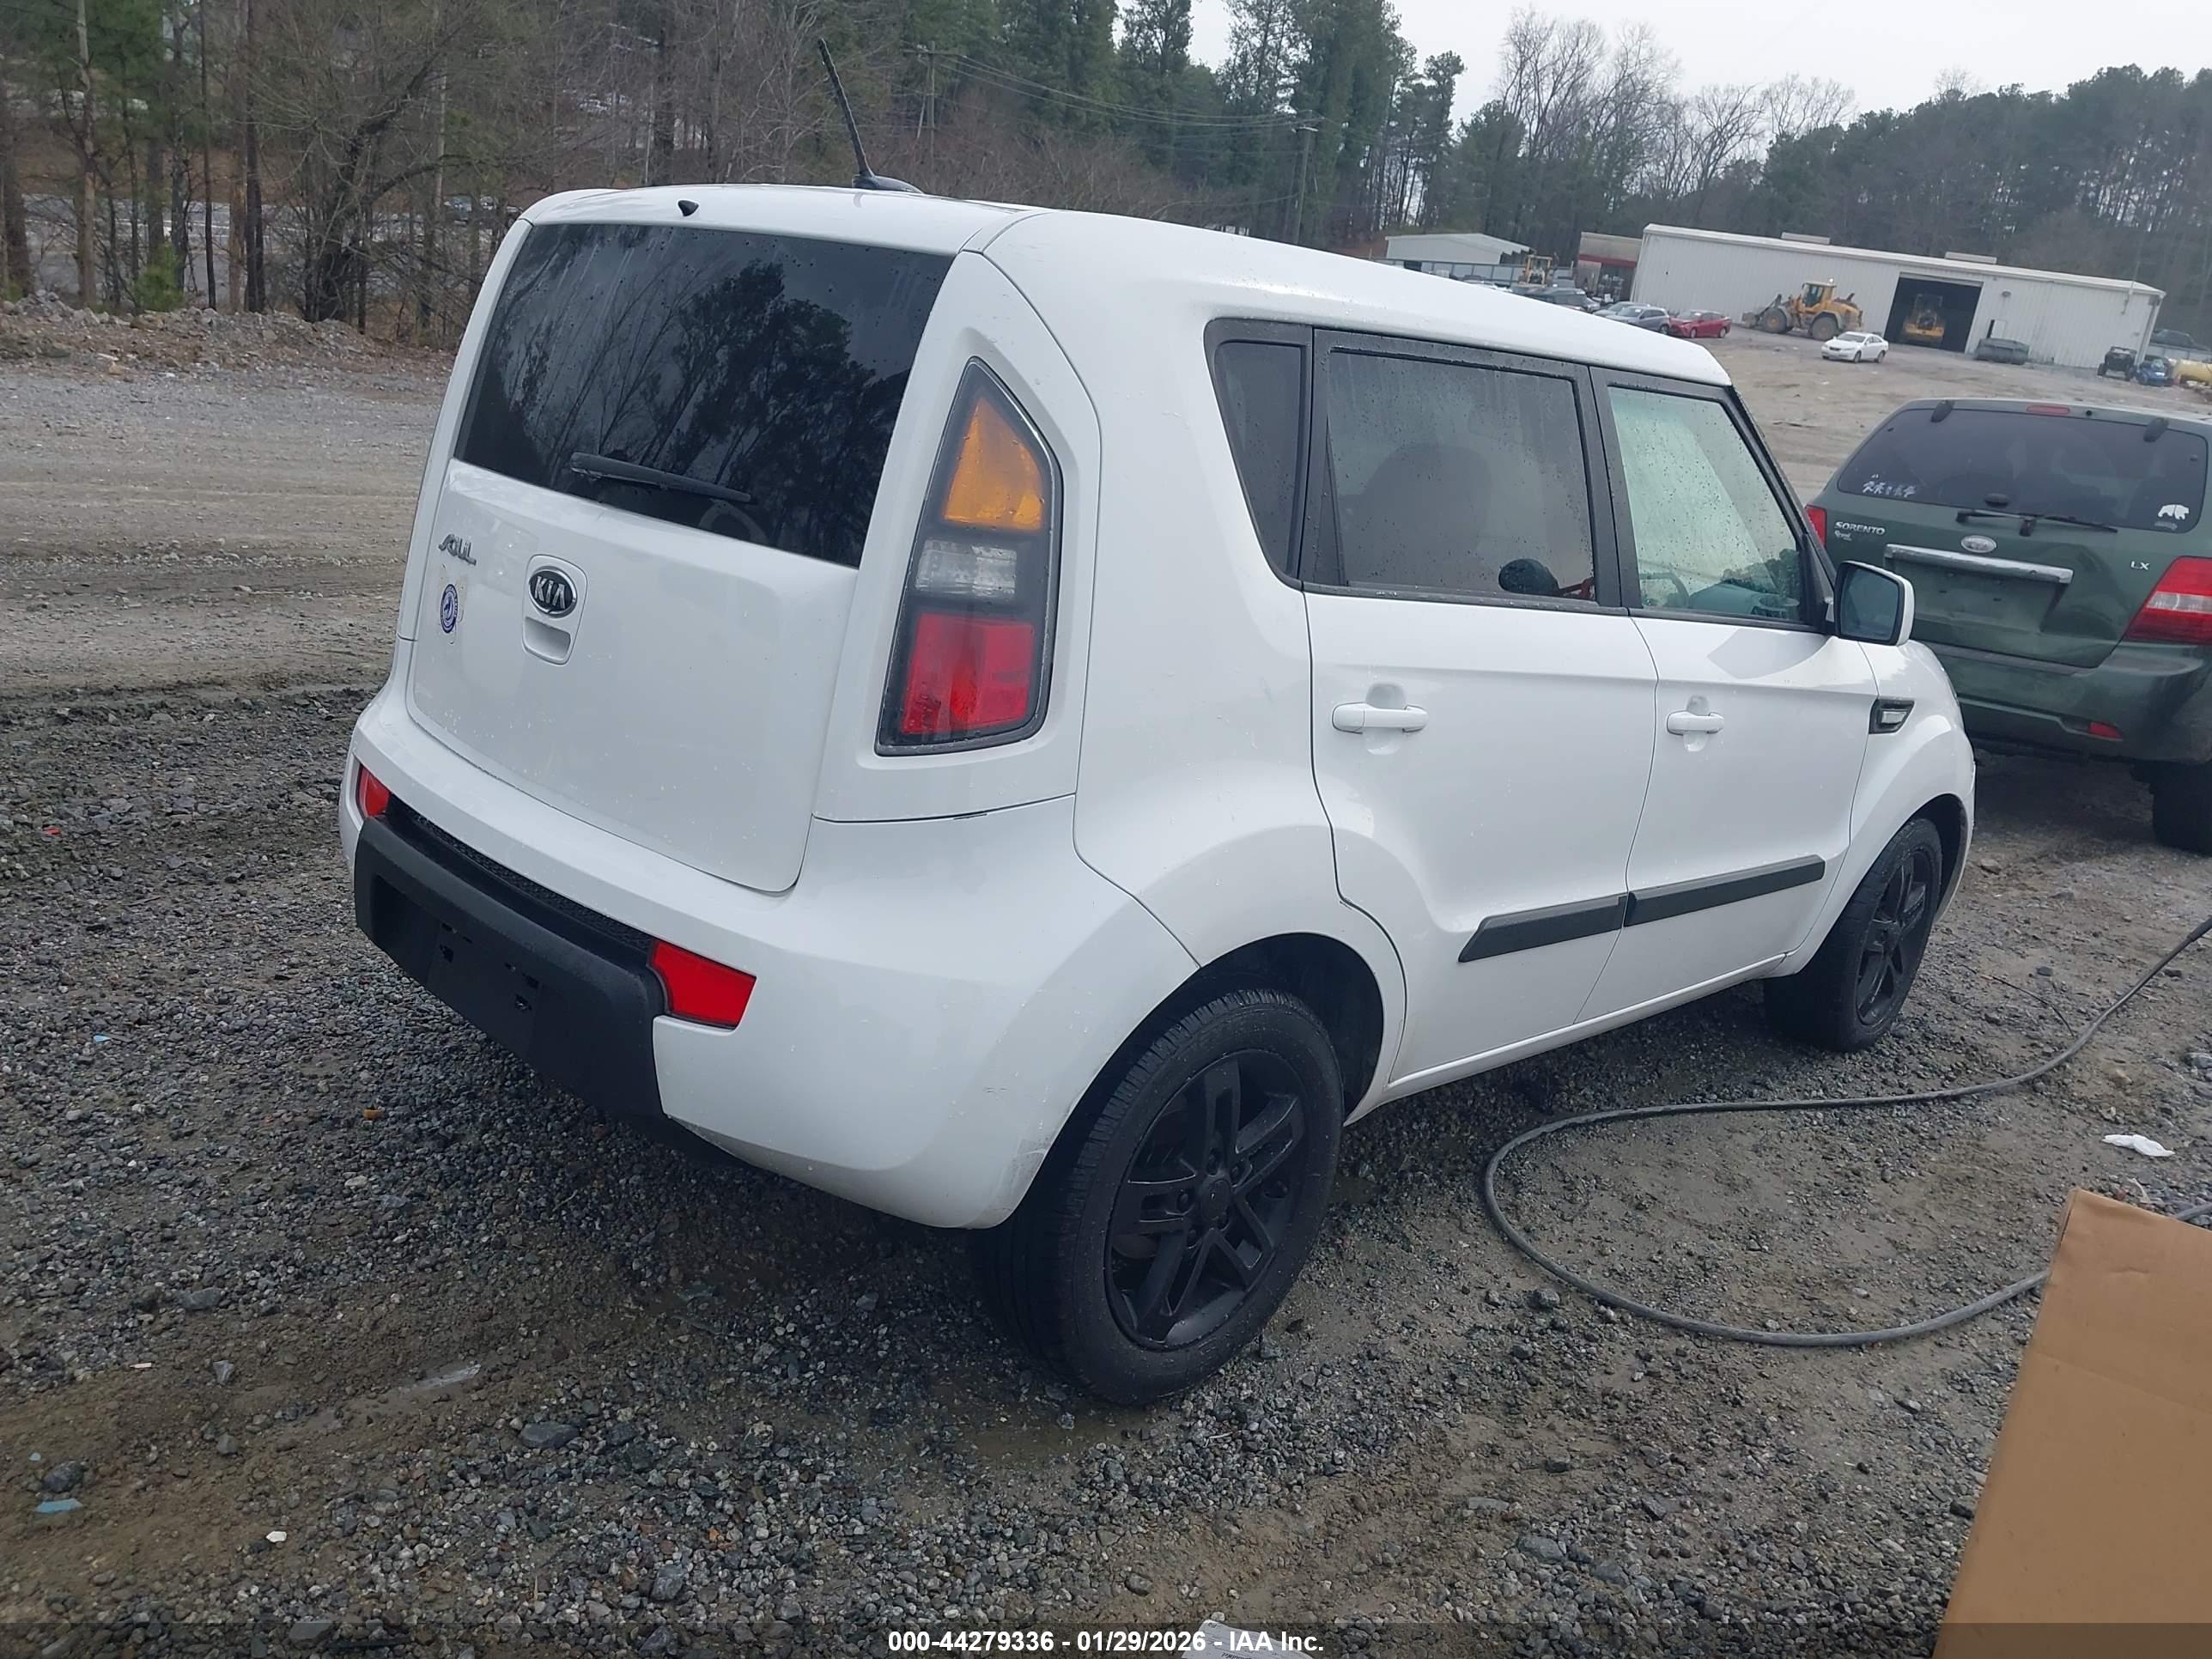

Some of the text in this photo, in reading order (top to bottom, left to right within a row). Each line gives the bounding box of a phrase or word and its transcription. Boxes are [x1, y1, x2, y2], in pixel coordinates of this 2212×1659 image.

[1834, 521, 1886, 535] SORENTO
[2130, 561, 2150, 571] LX
[534, 575, 567, 610] KIA
